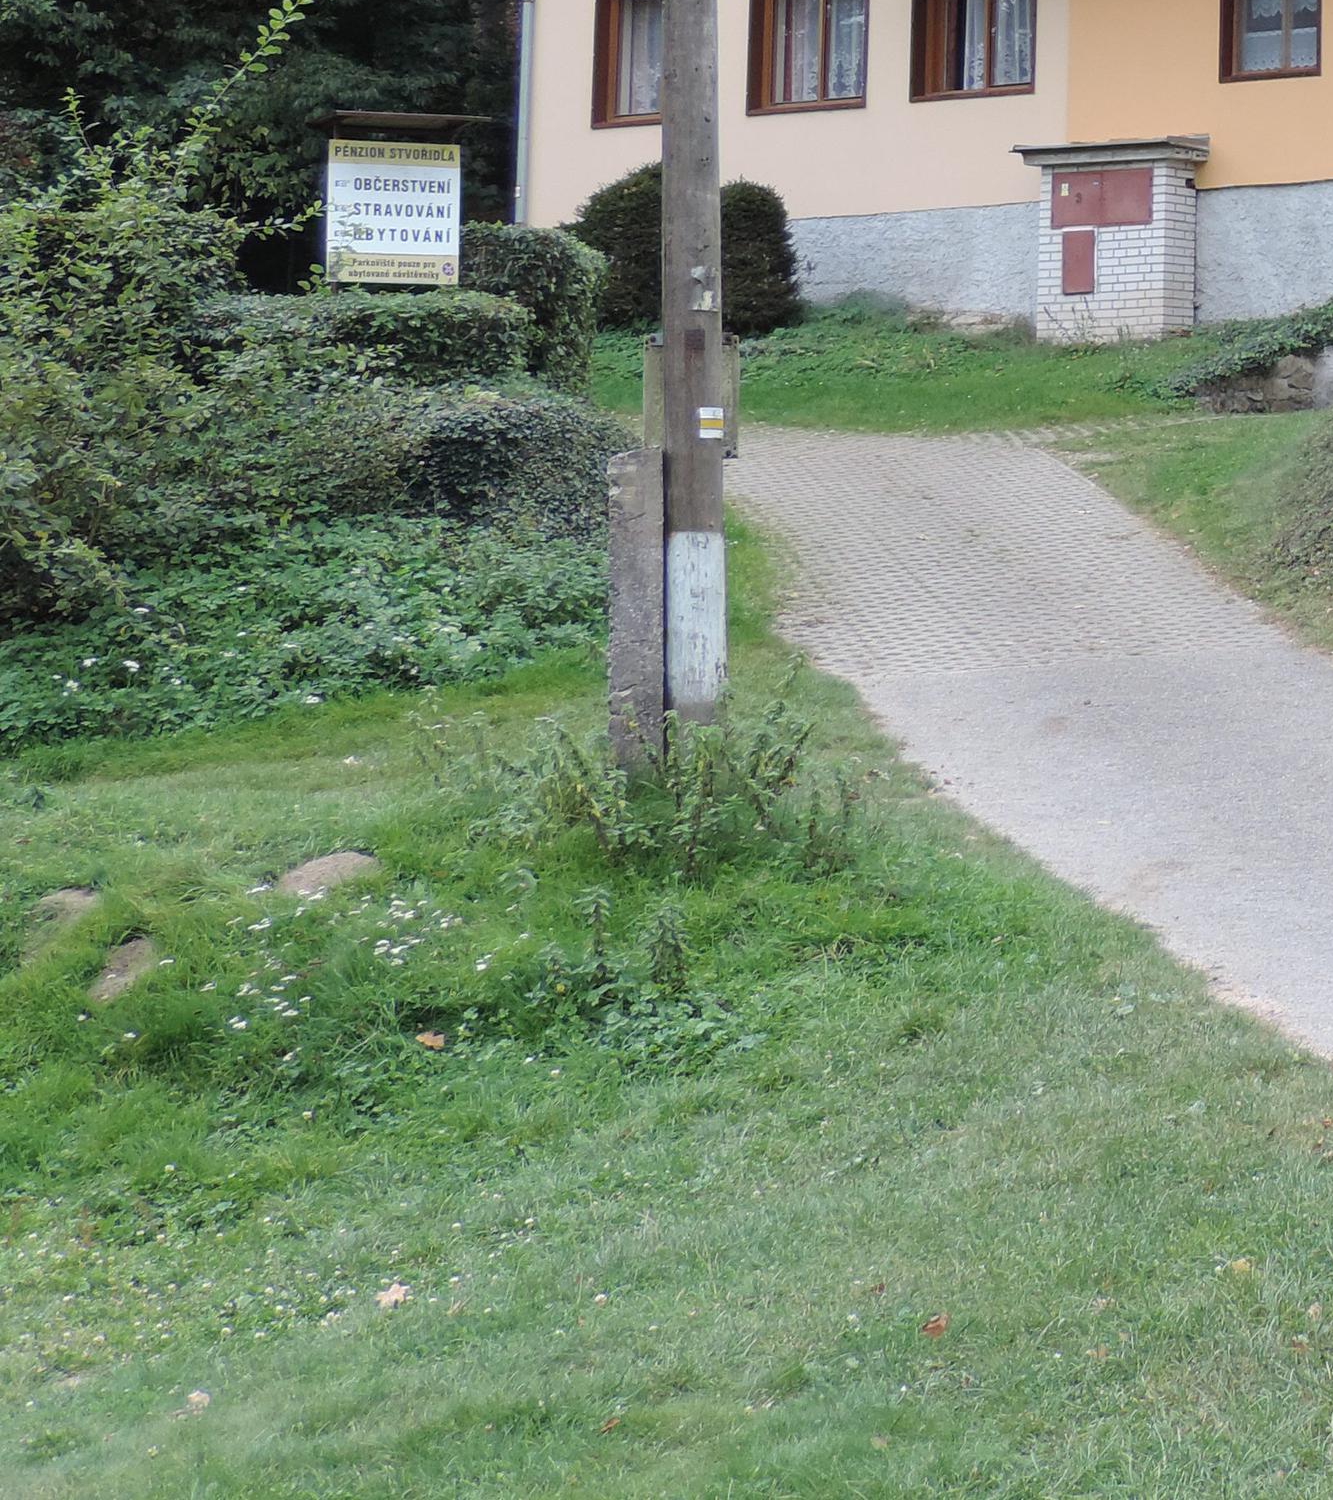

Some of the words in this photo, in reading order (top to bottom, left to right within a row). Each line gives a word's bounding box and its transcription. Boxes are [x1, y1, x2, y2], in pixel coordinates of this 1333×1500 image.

[334, 145, 386, 158] PENZION
[390, 147, 456, 162] STVOŘIDLA
[354, 175, 452, 194] OBČERSTVENÍ
[353, 202, 452, 219] STRAVOVÁNÍ
